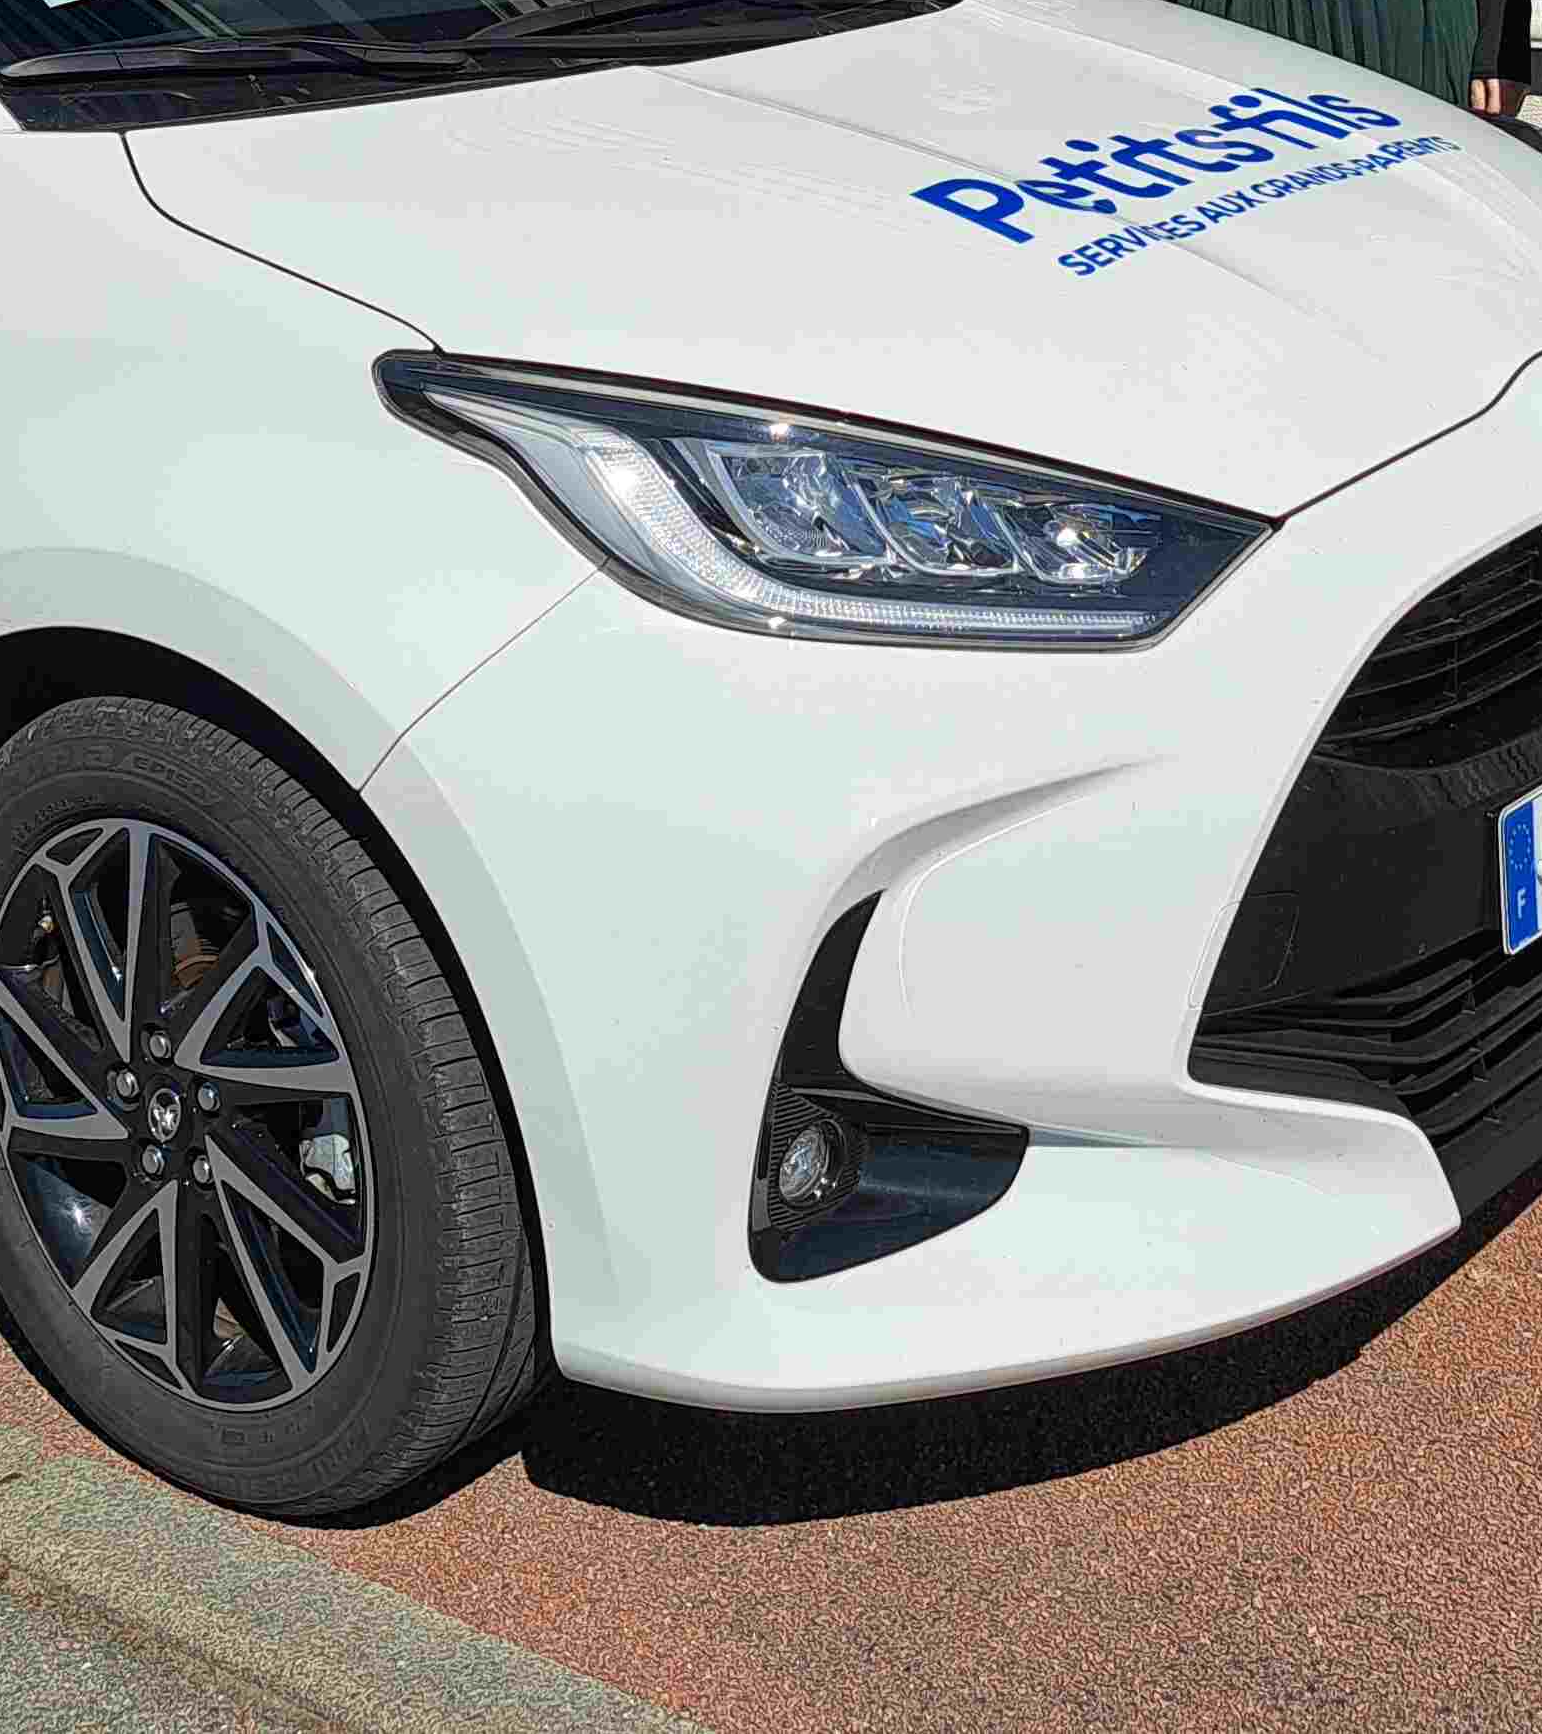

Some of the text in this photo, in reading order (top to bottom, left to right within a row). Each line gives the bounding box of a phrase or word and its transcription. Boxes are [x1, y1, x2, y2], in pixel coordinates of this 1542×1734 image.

[1056, 135, 1463, 278] SERVICES AUX GRANDS-PARENTS
[1515, 888, 1528, 920] F
